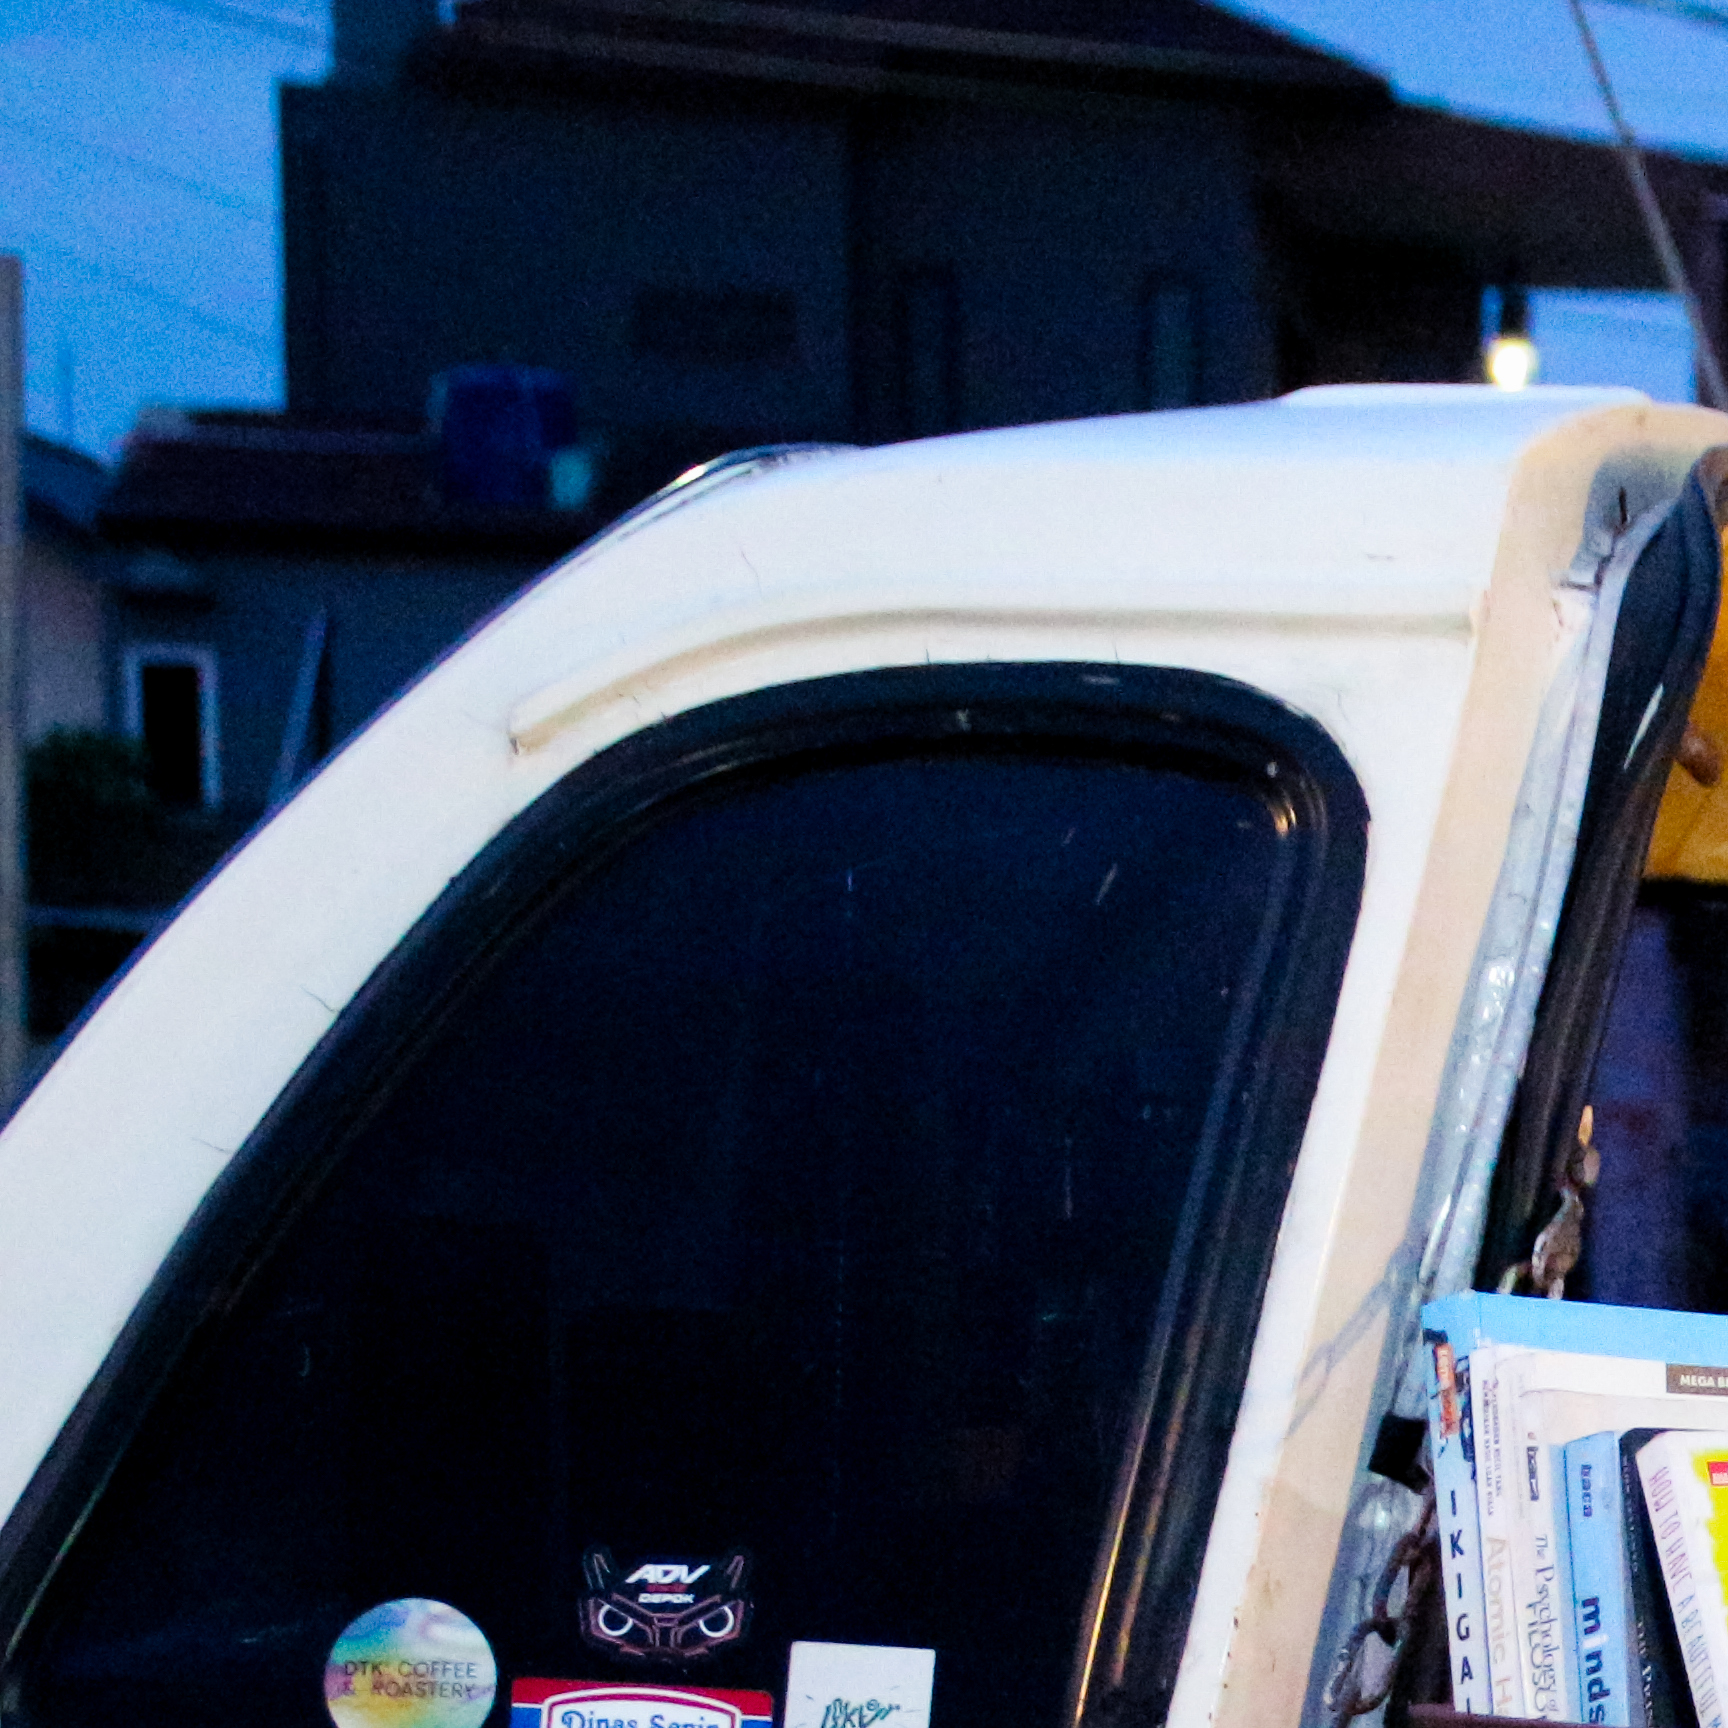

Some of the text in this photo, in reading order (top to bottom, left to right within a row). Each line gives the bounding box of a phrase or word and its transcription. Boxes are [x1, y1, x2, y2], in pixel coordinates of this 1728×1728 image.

[1680, 1374, 1716, 1387] MEGA
[625, 1563, 711, 1584] ADV
[1485, 1535, 1508, 1665] Atomic
[344, 1660, 478, 1679] DTK COFFEE
[371, 1681, 475, 1699] ROASTERY
